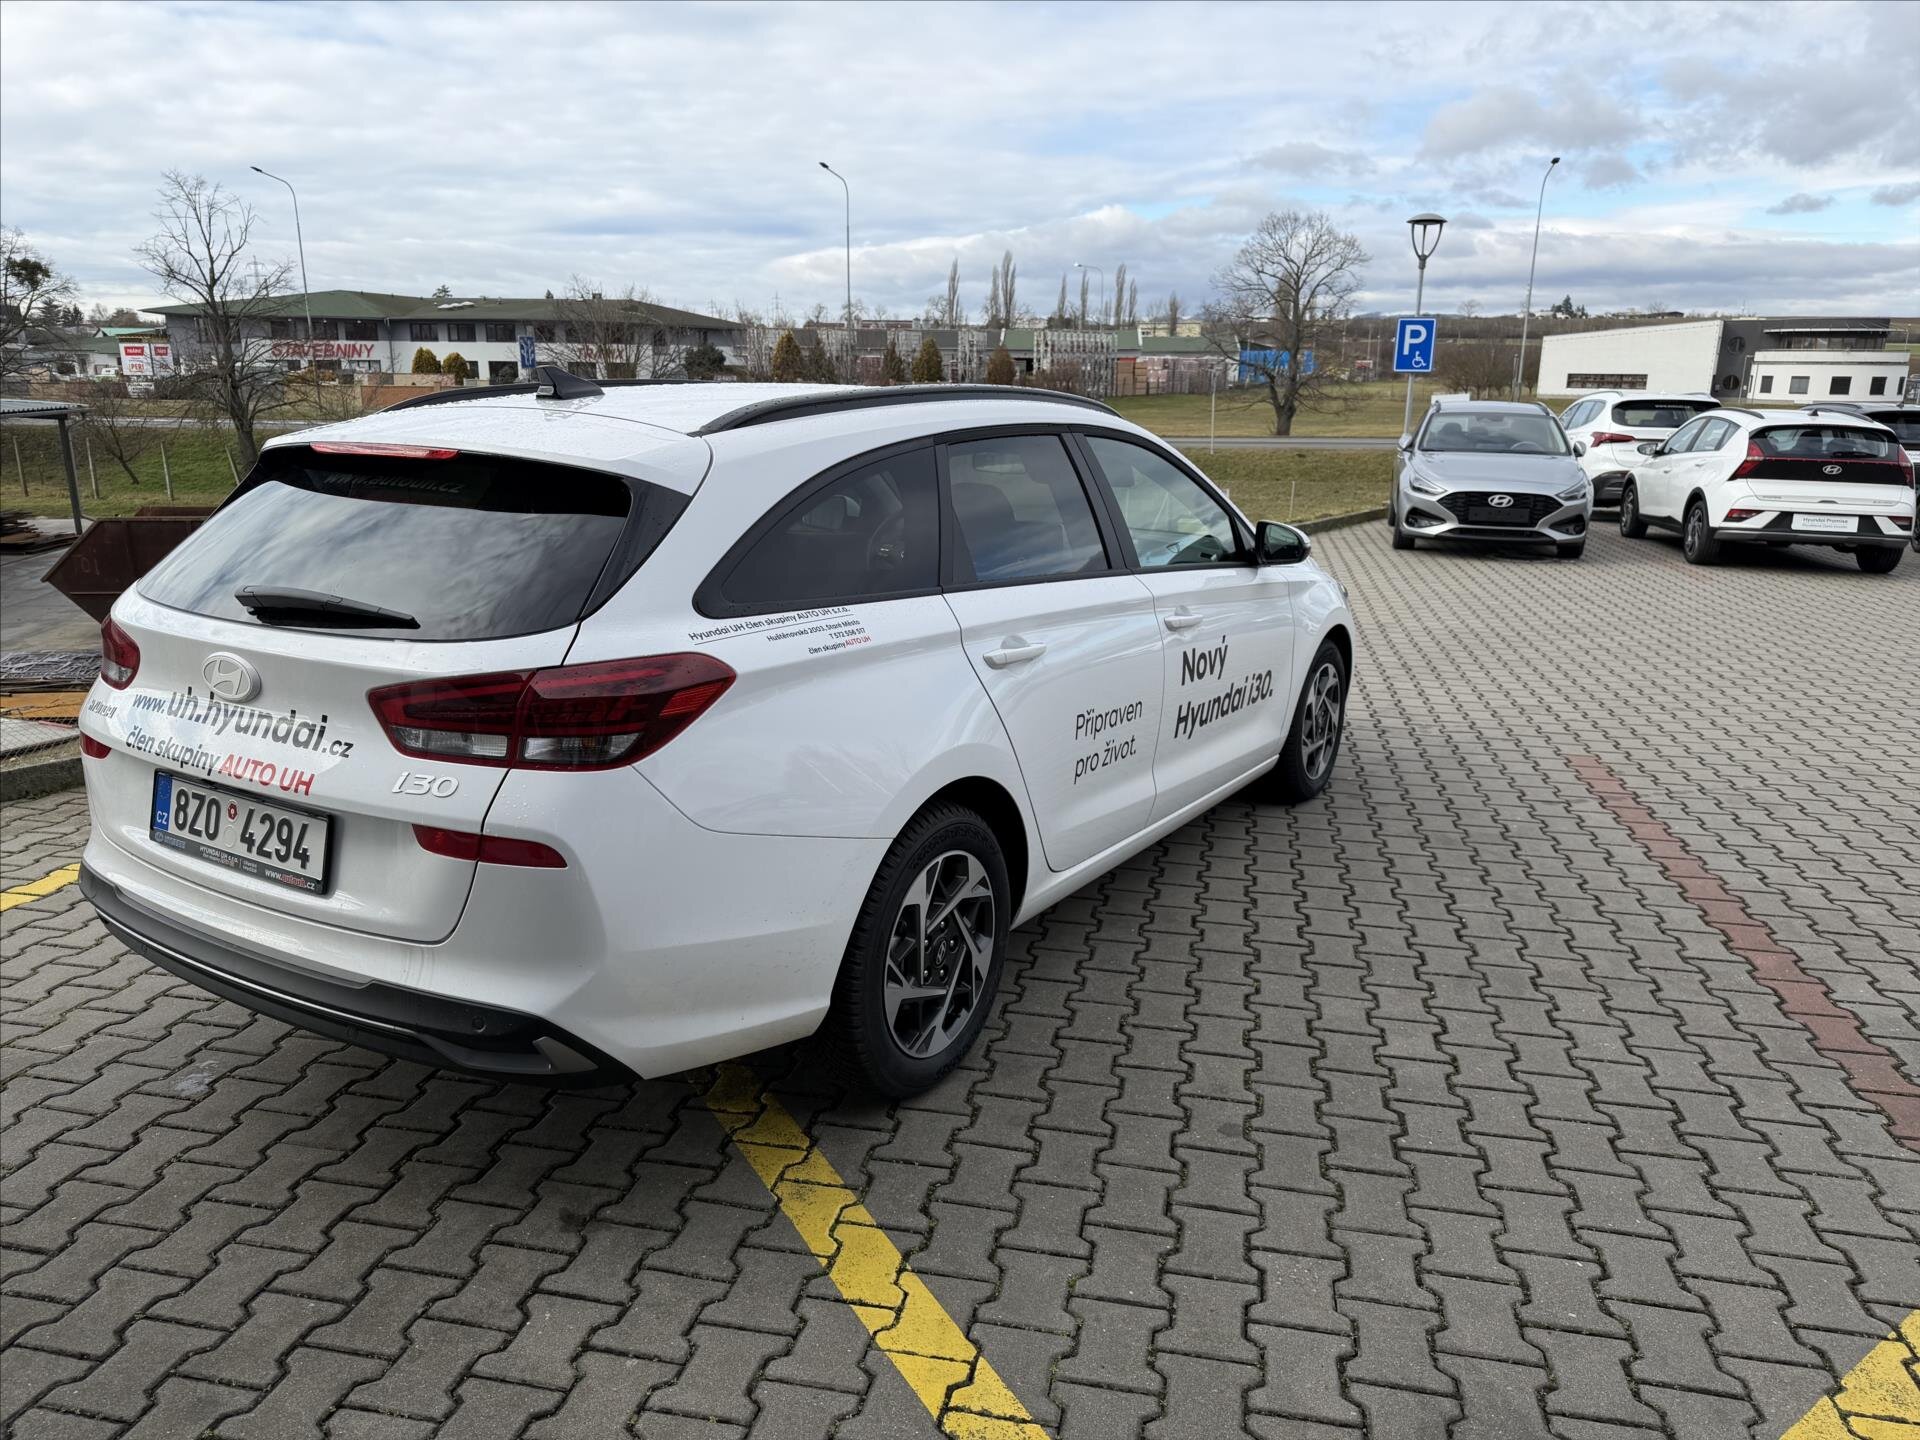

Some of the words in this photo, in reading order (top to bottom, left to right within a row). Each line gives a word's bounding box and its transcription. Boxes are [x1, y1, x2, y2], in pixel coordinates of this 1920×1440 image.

[271, 341, 375, 359] STAVEBNINY
[1403, 324, 1427, 355] P
[688, 626, 731, 641] Hyundai
[729, 623, 746, 633] UH
[745, 620, 765, 629] člen
[765, 613, 797, 626] skupiny
[797, 608, 819, 620] AUTO
[817, 607, 832, 617] UH
[831, 606, 851, 614] s.r.o.
[834, 631, 845, 639] 572
[808, 646, 822, 654] člen
[822, 640, 846, 651] skupiny
[845, 637, 861, 647] AUTO
[861, 635, 871, 643] UH
[1181, 635, 1228, 686] Nový
[1075, 700, 1143, 740] Připraven
[1174, 676, 1249, 739] Hyundai
[1246, 669, 1273, 706] i30.
[126, 724, 156, 754] člen
[155, 736, 220, 776] skupiny
[218, 753, 277, 786] AUTO
[279, 766, 315, 796] UH
[1074, 752, 1099, 784] pro
[1102, 735, 1137, 767] život.
[391, 771, 460, 798] i30
[156, 811, 168, 825] CZ
[239, 807, 311, 870] 4294
